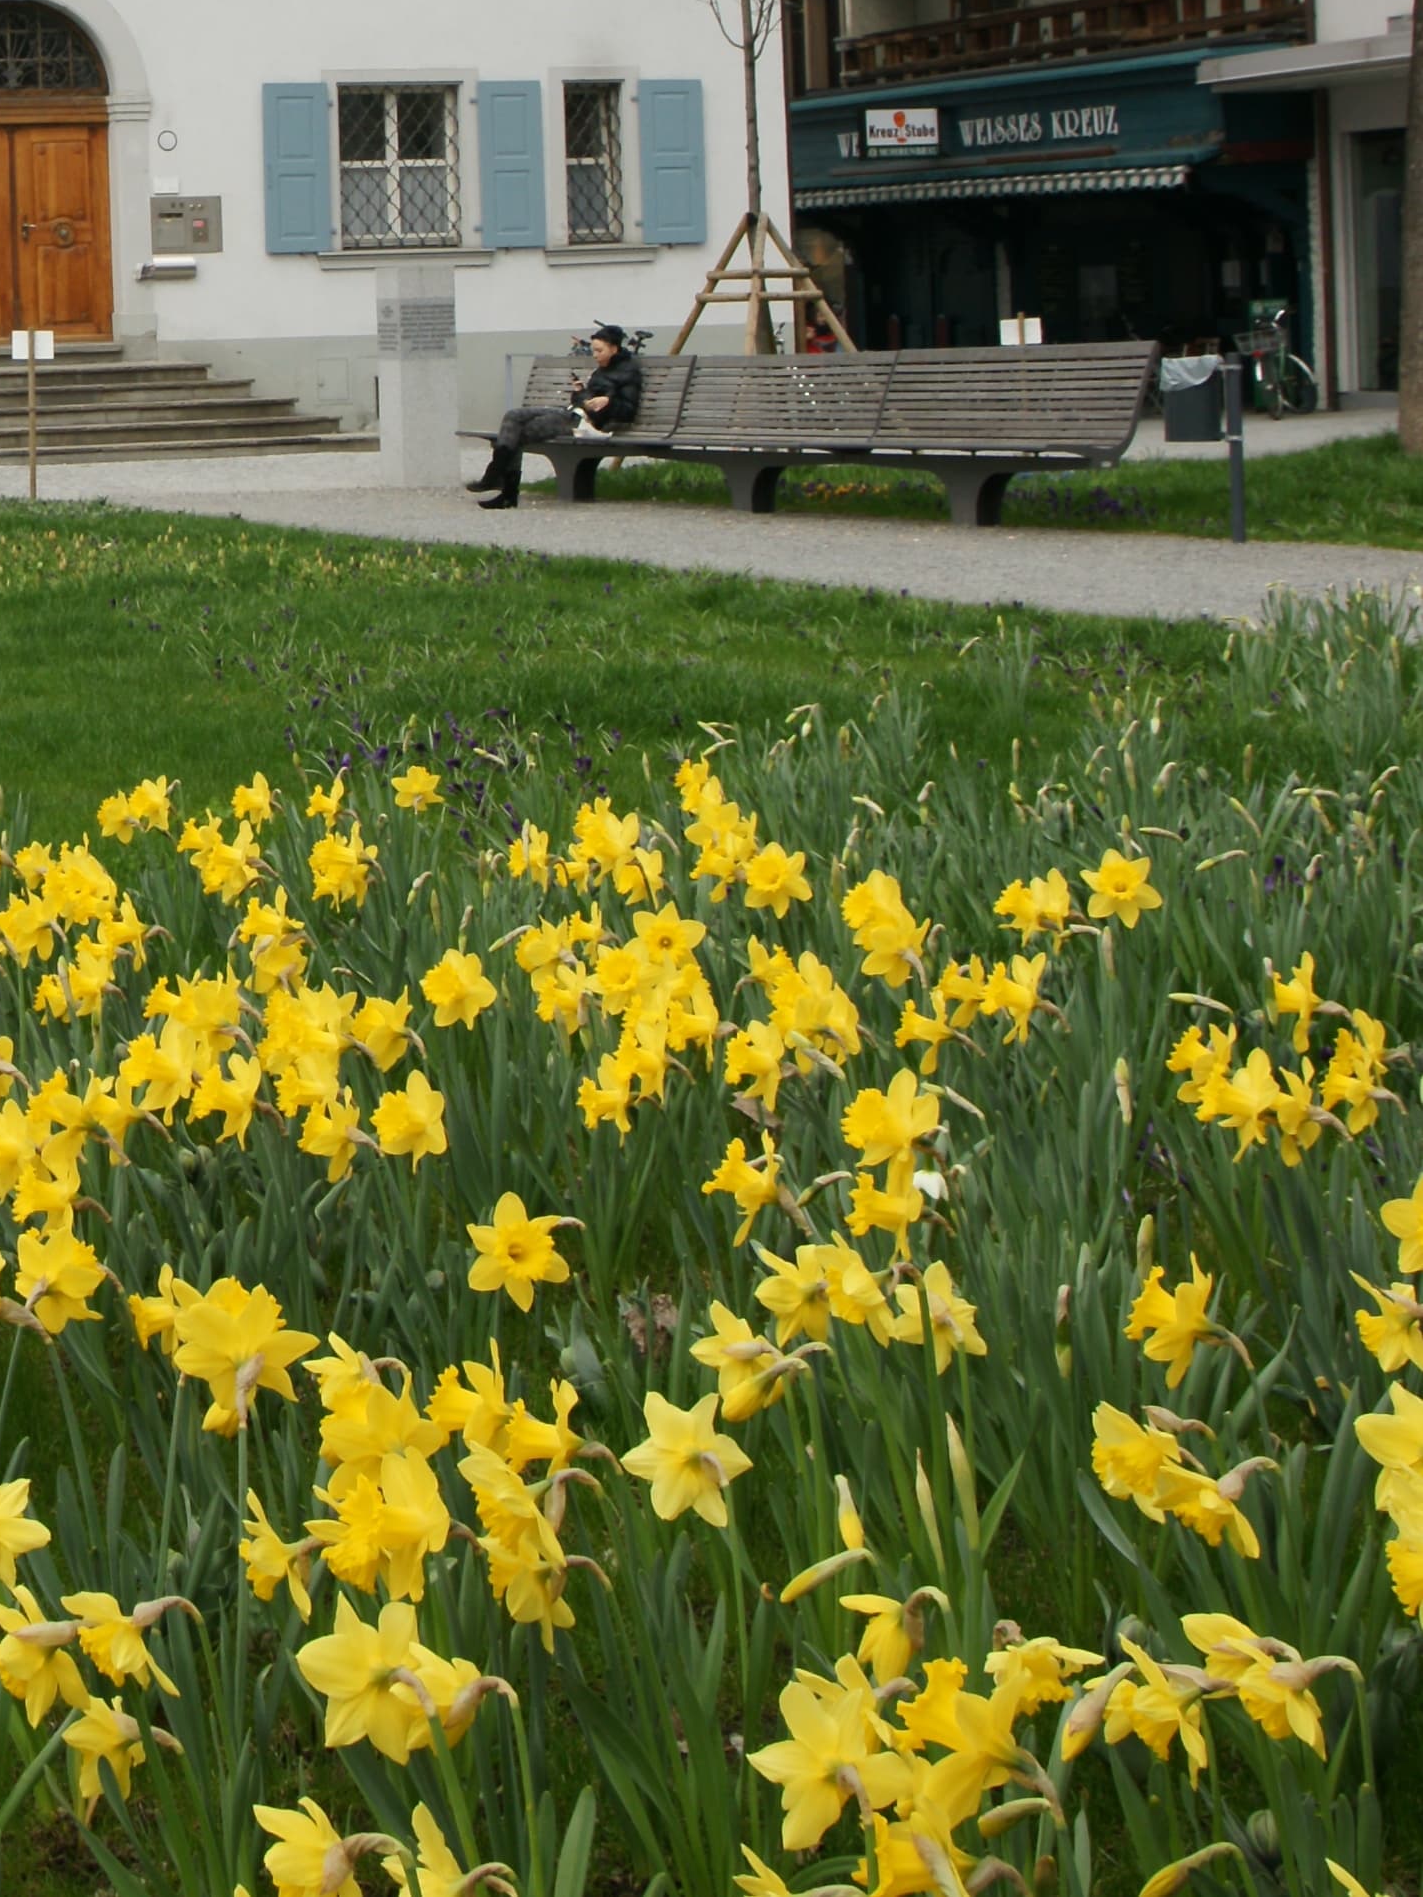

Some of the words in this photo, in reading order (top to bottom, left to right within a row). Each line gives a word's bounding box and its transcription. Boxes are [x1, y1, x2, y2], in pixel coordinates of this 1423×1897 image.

[868, 124, 898, 139] Kreuz
[904, 123, 936, 138] Stube
[958, 111, 1042, 147] WEISSES
[1050, 105, 1119, 139] KREUZ
